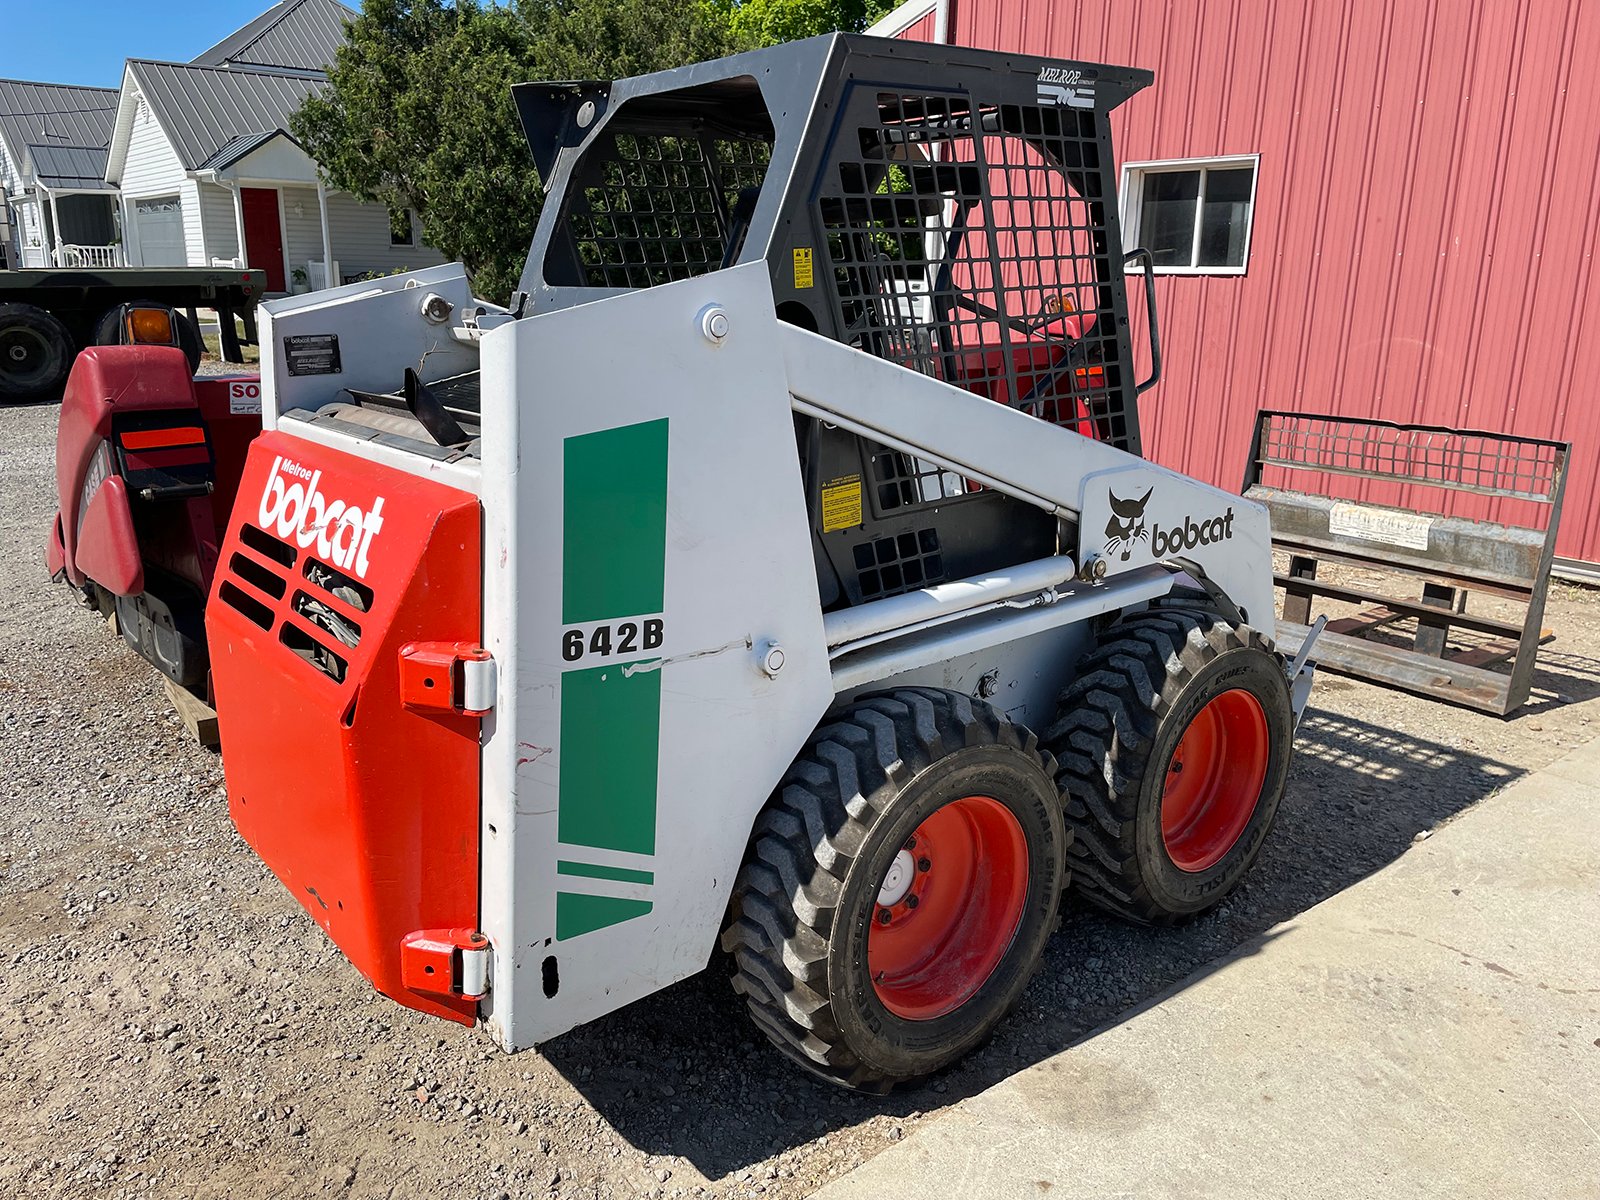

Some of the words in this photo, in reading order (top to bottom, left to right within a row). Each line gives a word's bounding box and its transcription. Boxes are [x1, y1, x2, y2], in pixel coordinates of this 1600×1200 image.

[1037, 66, 1081, 84] MELROE
[280, 458, 313, 481] Melroe
[258, 455, 386, 579] bobcat
[1151, 506, 1235, 559] bobcat
[562, 618, 665, 662] 642B
[1032, 799, 1054, 843] TRAC
[1040, 856, 1055, 920] CHIEF
